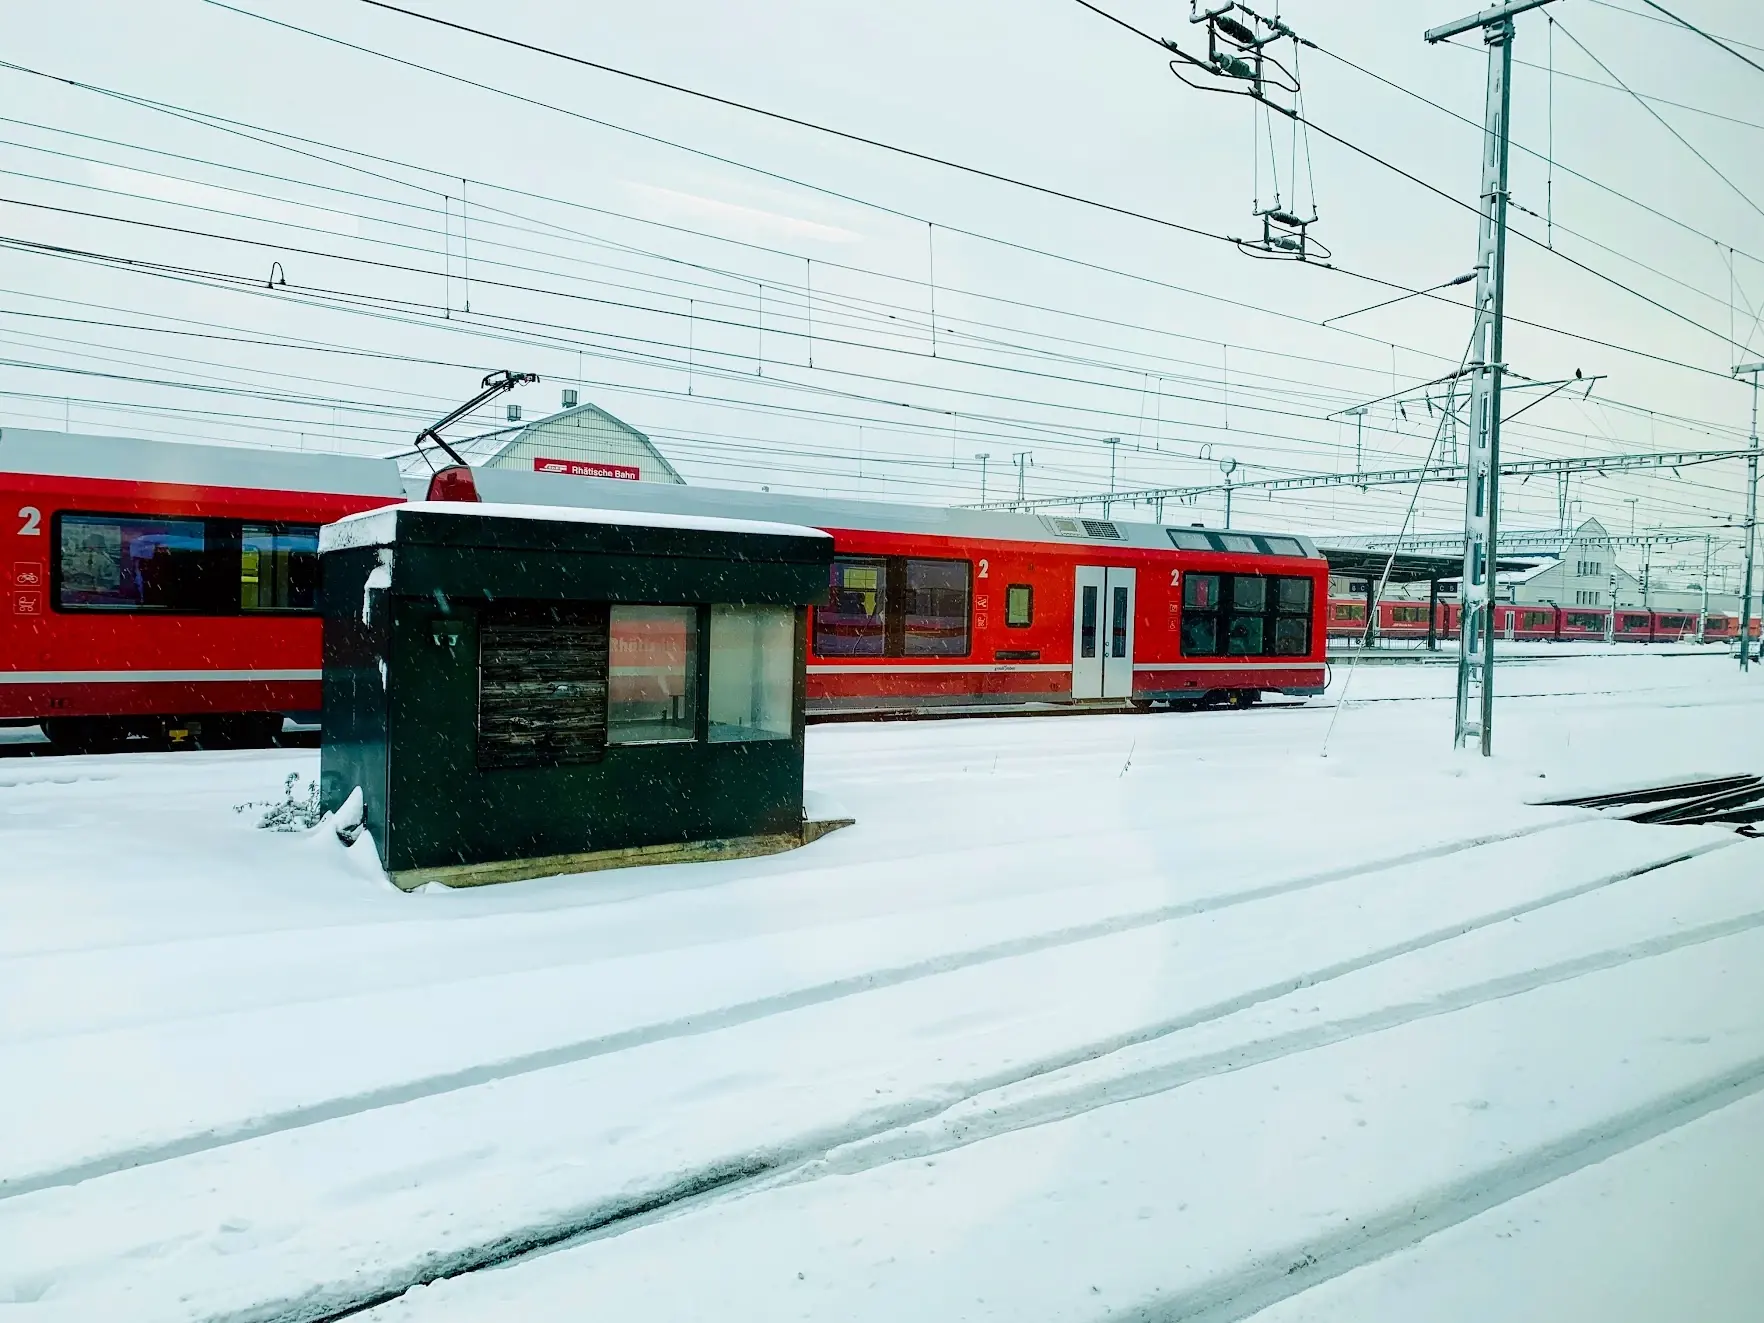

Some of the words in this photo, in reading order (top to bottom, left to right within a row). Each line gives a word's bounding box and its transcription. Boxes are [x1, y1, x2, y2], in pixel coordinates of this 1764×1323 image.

[572, 466, 613, 477] Rhätische
[614, 471, 636, 479] Bahn
[17, 506, 41, 535] 2
[977, 559, 989, 578] 2
[1170, 569, 1179, 586] 2
